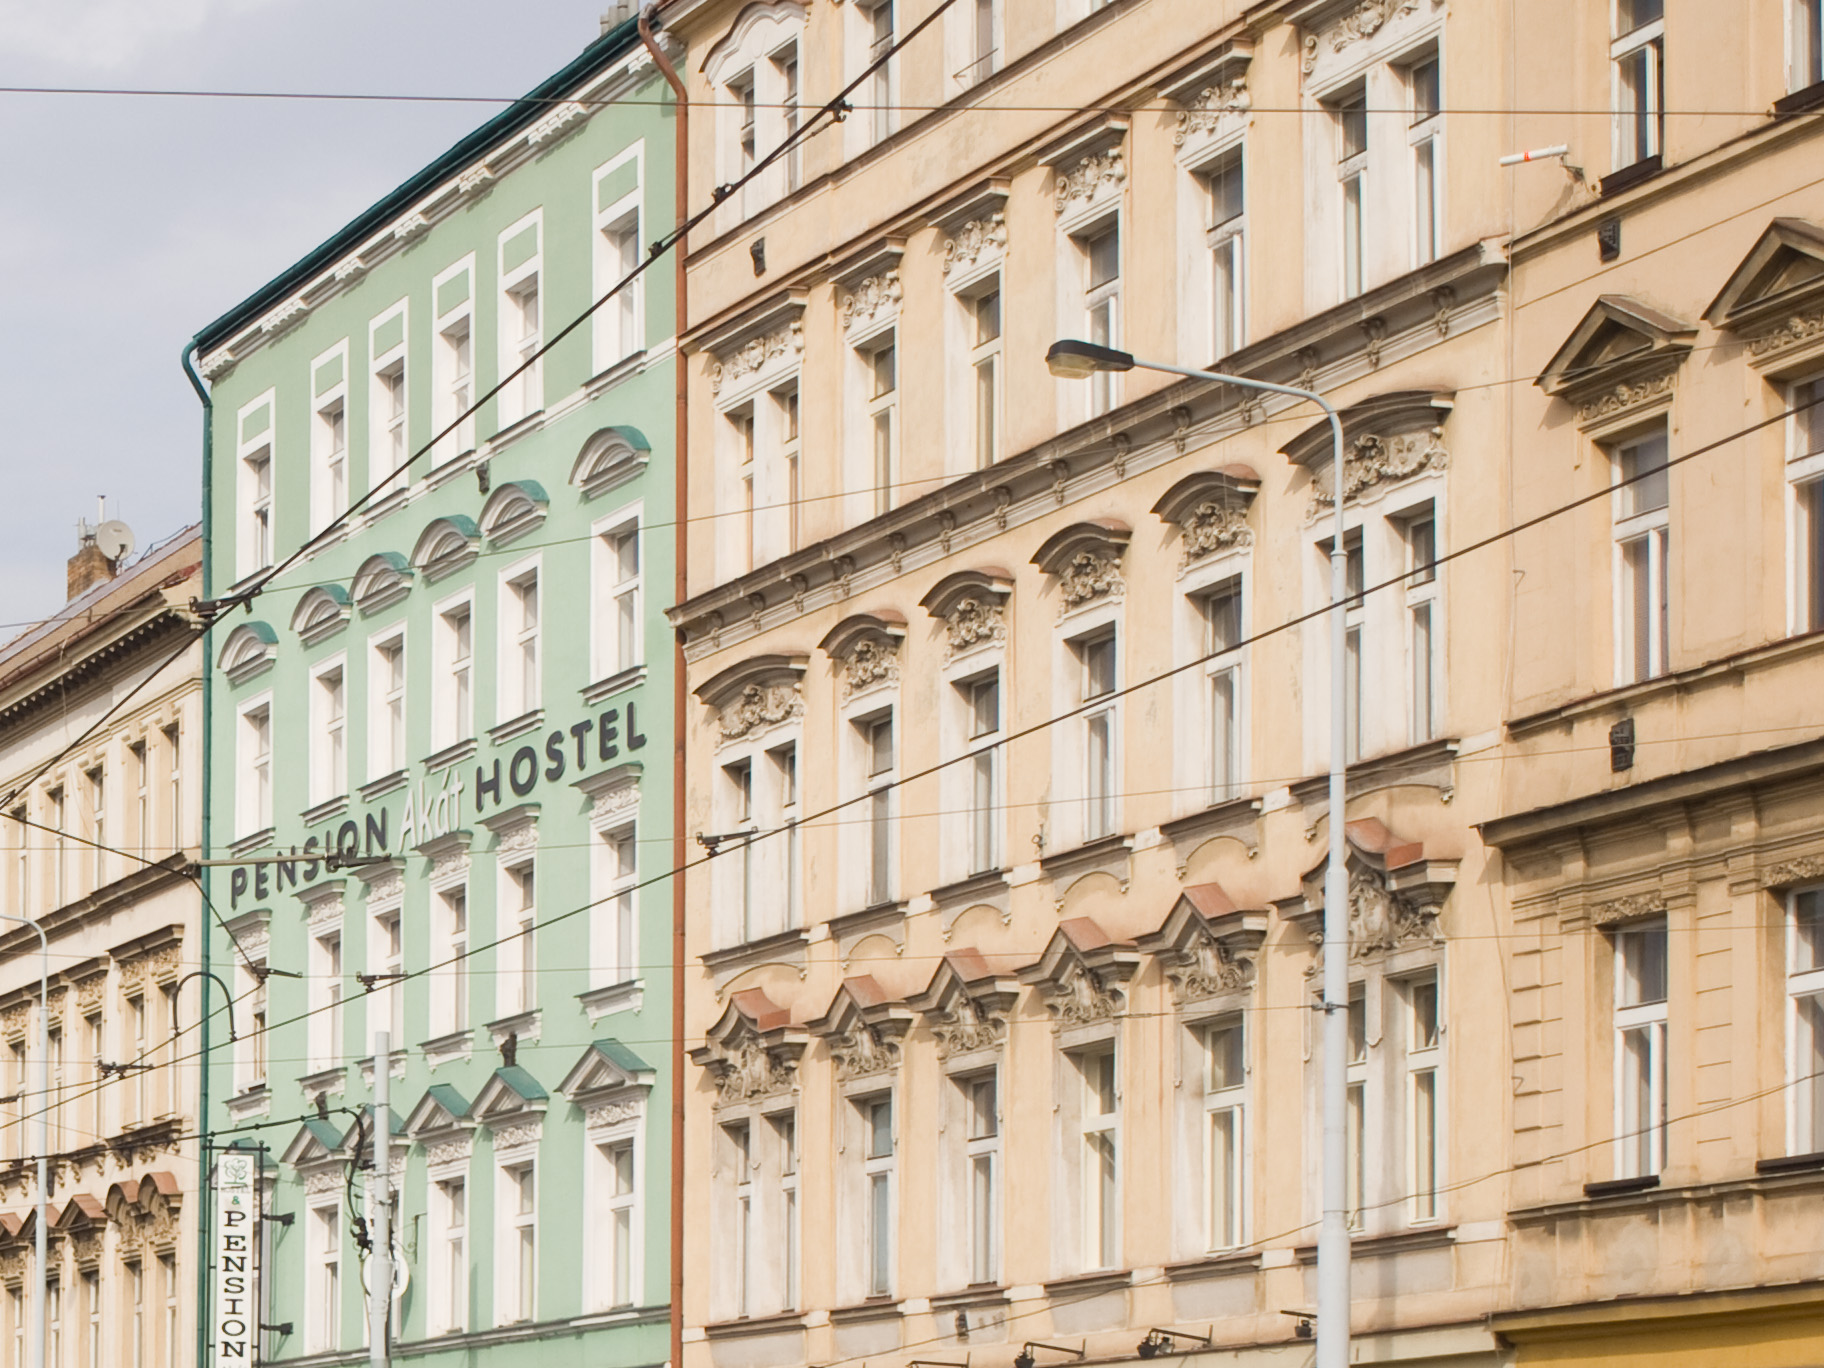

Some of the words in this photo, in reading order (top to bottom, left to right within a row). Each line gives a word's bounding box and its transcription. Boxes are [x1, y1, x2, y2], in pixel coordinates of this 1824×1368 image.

[230, 807, 388, 910] PENSION
[397, 767, 465, 852] Akát
[475, 702, 648, 812] HOSTEL
[221, 1211, 247, 1358] PENSION
